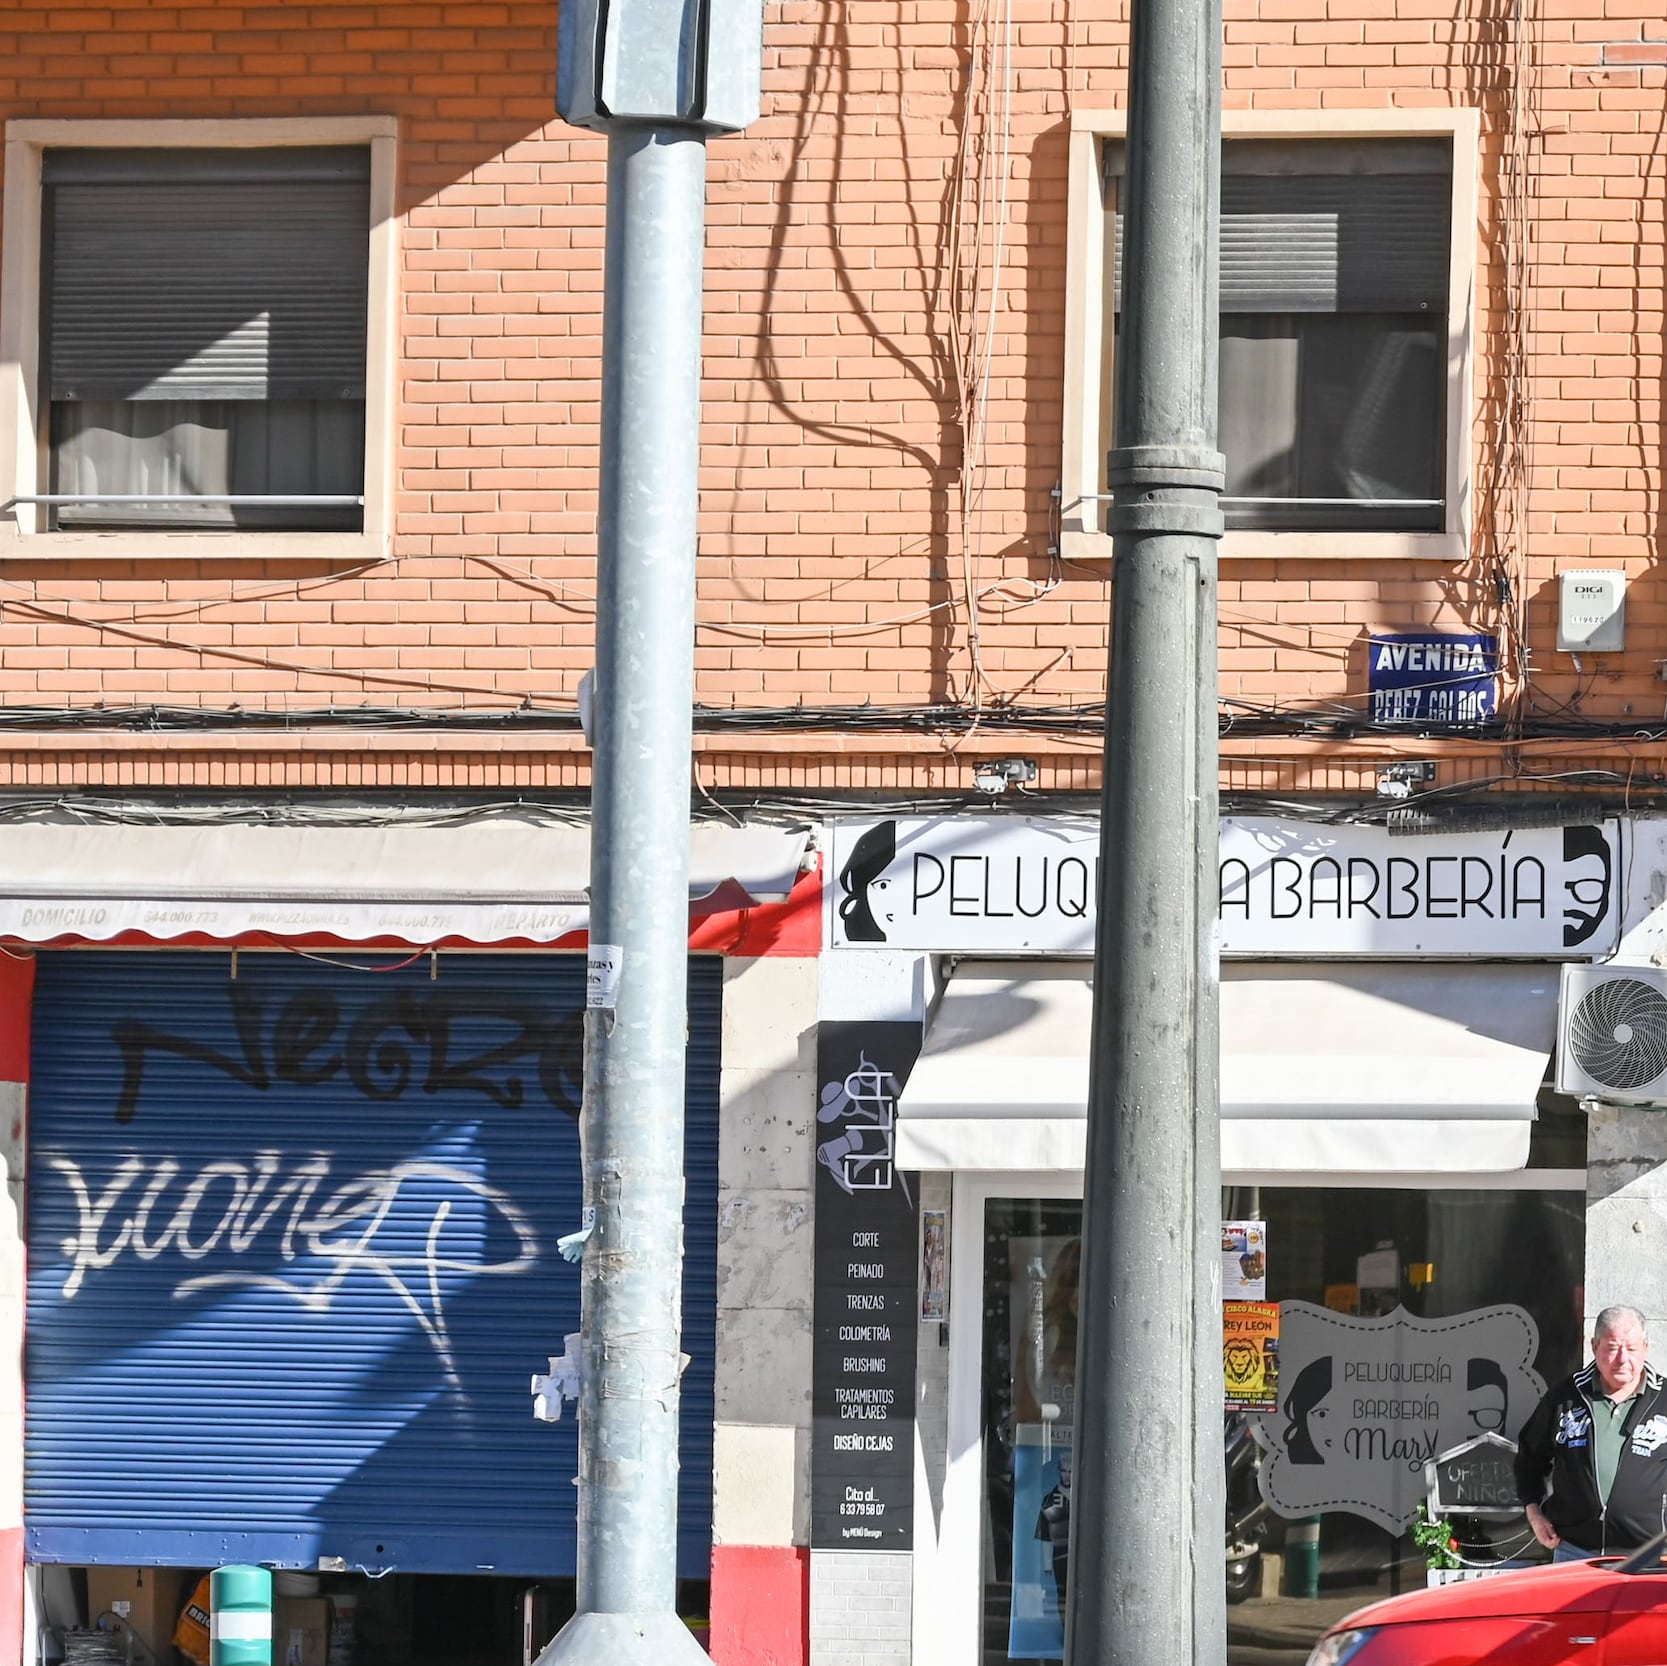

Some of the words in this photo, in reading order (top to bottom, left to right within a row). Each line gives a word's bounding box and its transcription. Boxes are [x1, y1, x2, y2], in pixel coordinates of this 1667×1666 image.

[1375, 643, 1487, 672] AVENIDA
[1271, 830, 1545, 920] BARBERÍA
[21, 908, 107, 927] DOMICILIO
[844, 1067, 893, 1190] ELLA
[852, 1232, 880, 1247] CORTE
[847, 1264, 884, 1279] PEINADO
[847, 1295, 885, 1310] TRENZAS
[839, 1323, 891, 1341] COLOMETRÍA
[1245, 1319, 1272, 1331] LEÓN
[843, 1357, 886, 1372] BRUSHING
[1345, 1356, 1451, 1382] PELUQUERÍA
[835, 1388, 894, 1403] TRATAMIENTOS
[840, 1404, 887, 1420] CAPILARES
[1353, 1393, 1440, 1420] BARBERÍA
[833, 1433, 864, 1450] DISEÑO
[865, 1435, 894, 1451] CEJAS
